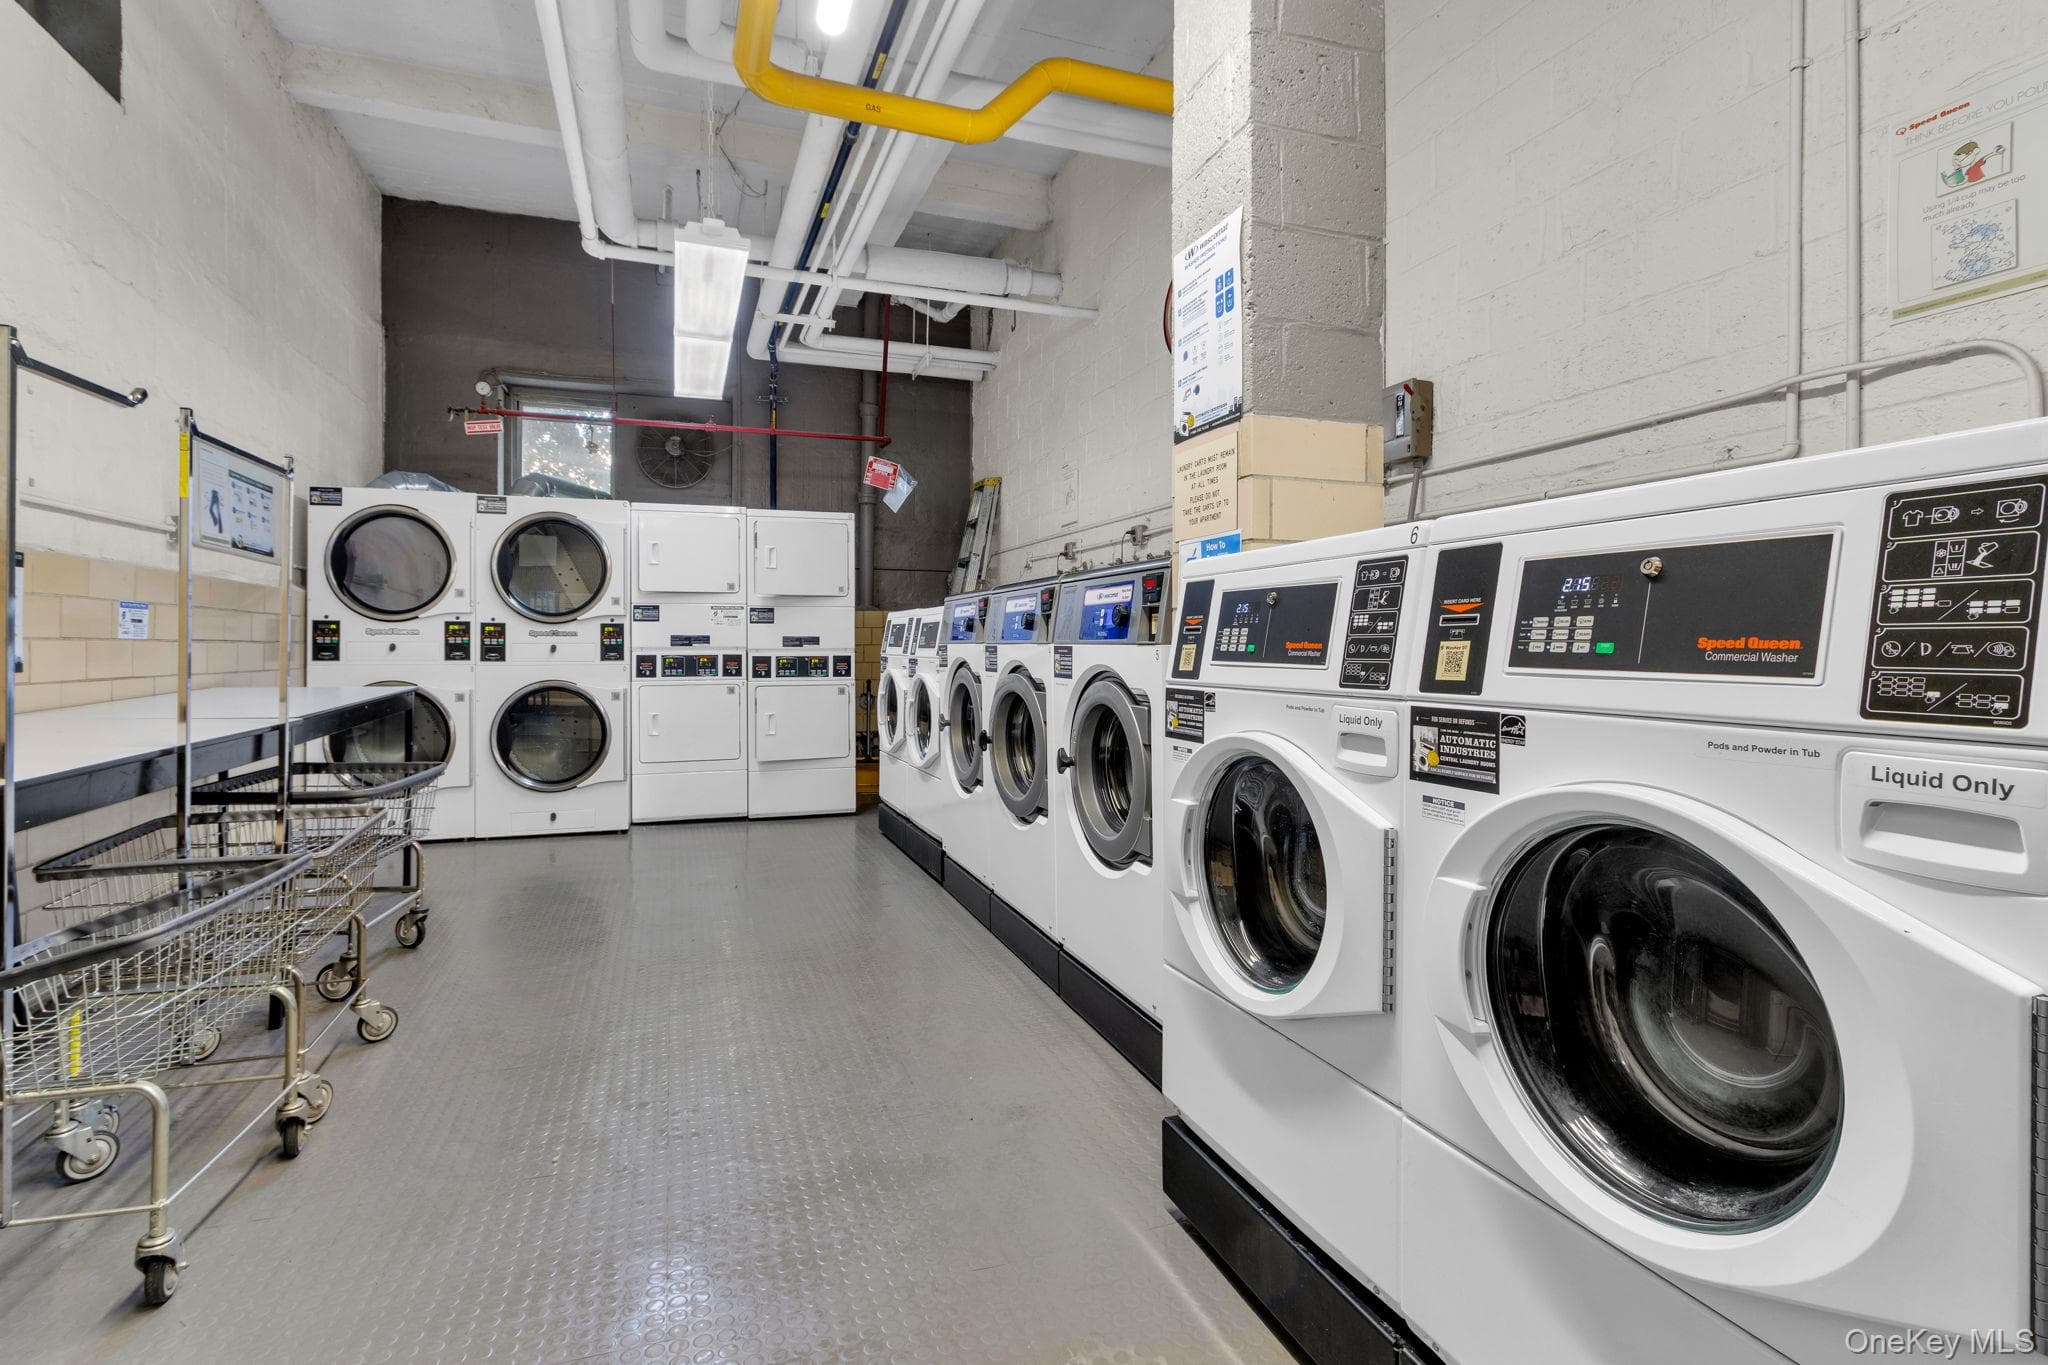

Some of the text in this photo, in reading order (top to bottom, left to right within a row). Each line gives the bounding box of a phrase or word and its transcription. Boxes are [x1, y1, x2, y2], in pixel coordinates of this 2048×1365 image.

[865, 103, 881, 112] GAS
[1904, 129, 1937, 146] THINK
[1938, 107, 1984, 133] BEFORE
[1986, 95, 2014, 112] YOU
[1908, 101, 1971, 131] Speed Queen
[1922, 201, 1946, 214] Using
[1961, 191, 1977, 201] cup
[1978, 184, 1996, 195] may
[1997, 180, 2010, 189] be
[2010, 174, 2026, 184] too
[1922, 210, 1945, 223] much
[1177, 448, 1235, 474] LAUNDRY CARTS MUST REMAIN
[1198, 466, 1215, 478] LAUNDRY
[1216, 462, 1228, 472] ROOM
[1198, 481, 1206, 489] ALL
[1207, 476, 1219, 486] TIMES
[1190, 489, 1221, 504] PLEASE DO NOT
[1183, 508, 1192, 517] TAKE
[1203, 502, 1215, 512] CARTS
[1216, 500, 1222, 508] UP
[1224, 498, 1230, 506] TO
[1189, 512, 1222, 526] YOUR APARTMENT
[1410, 526, 1419, 544] 6
[1206, 541, 1226, 552] How To
[1562, 576, 1591, 593] 2.15
[1285, 641, 1304, 650] Speed
[1696, 636, 1802, 651] Speed Queen
[1704, 651, 1799, 663] Commercial Washer
[1339, 713, 1383, 730] Liquid Only
[1439, 716, 1452, 724] SERVICE
[1440, 734, 1496, 749] AUTOMATIC
[1440, 744, 1496, 759] INDUSTRIES
[1707, 741, 1821, 758] Pods and Powder in Tub
[1440, 755, 1458, 763] CENTRAL
[1459, 758, 1480, 766] LAUNDRY
[1871, 765, 2015, 801] Liquid Only
[1432, 797, 1455, 807] NOTICE
